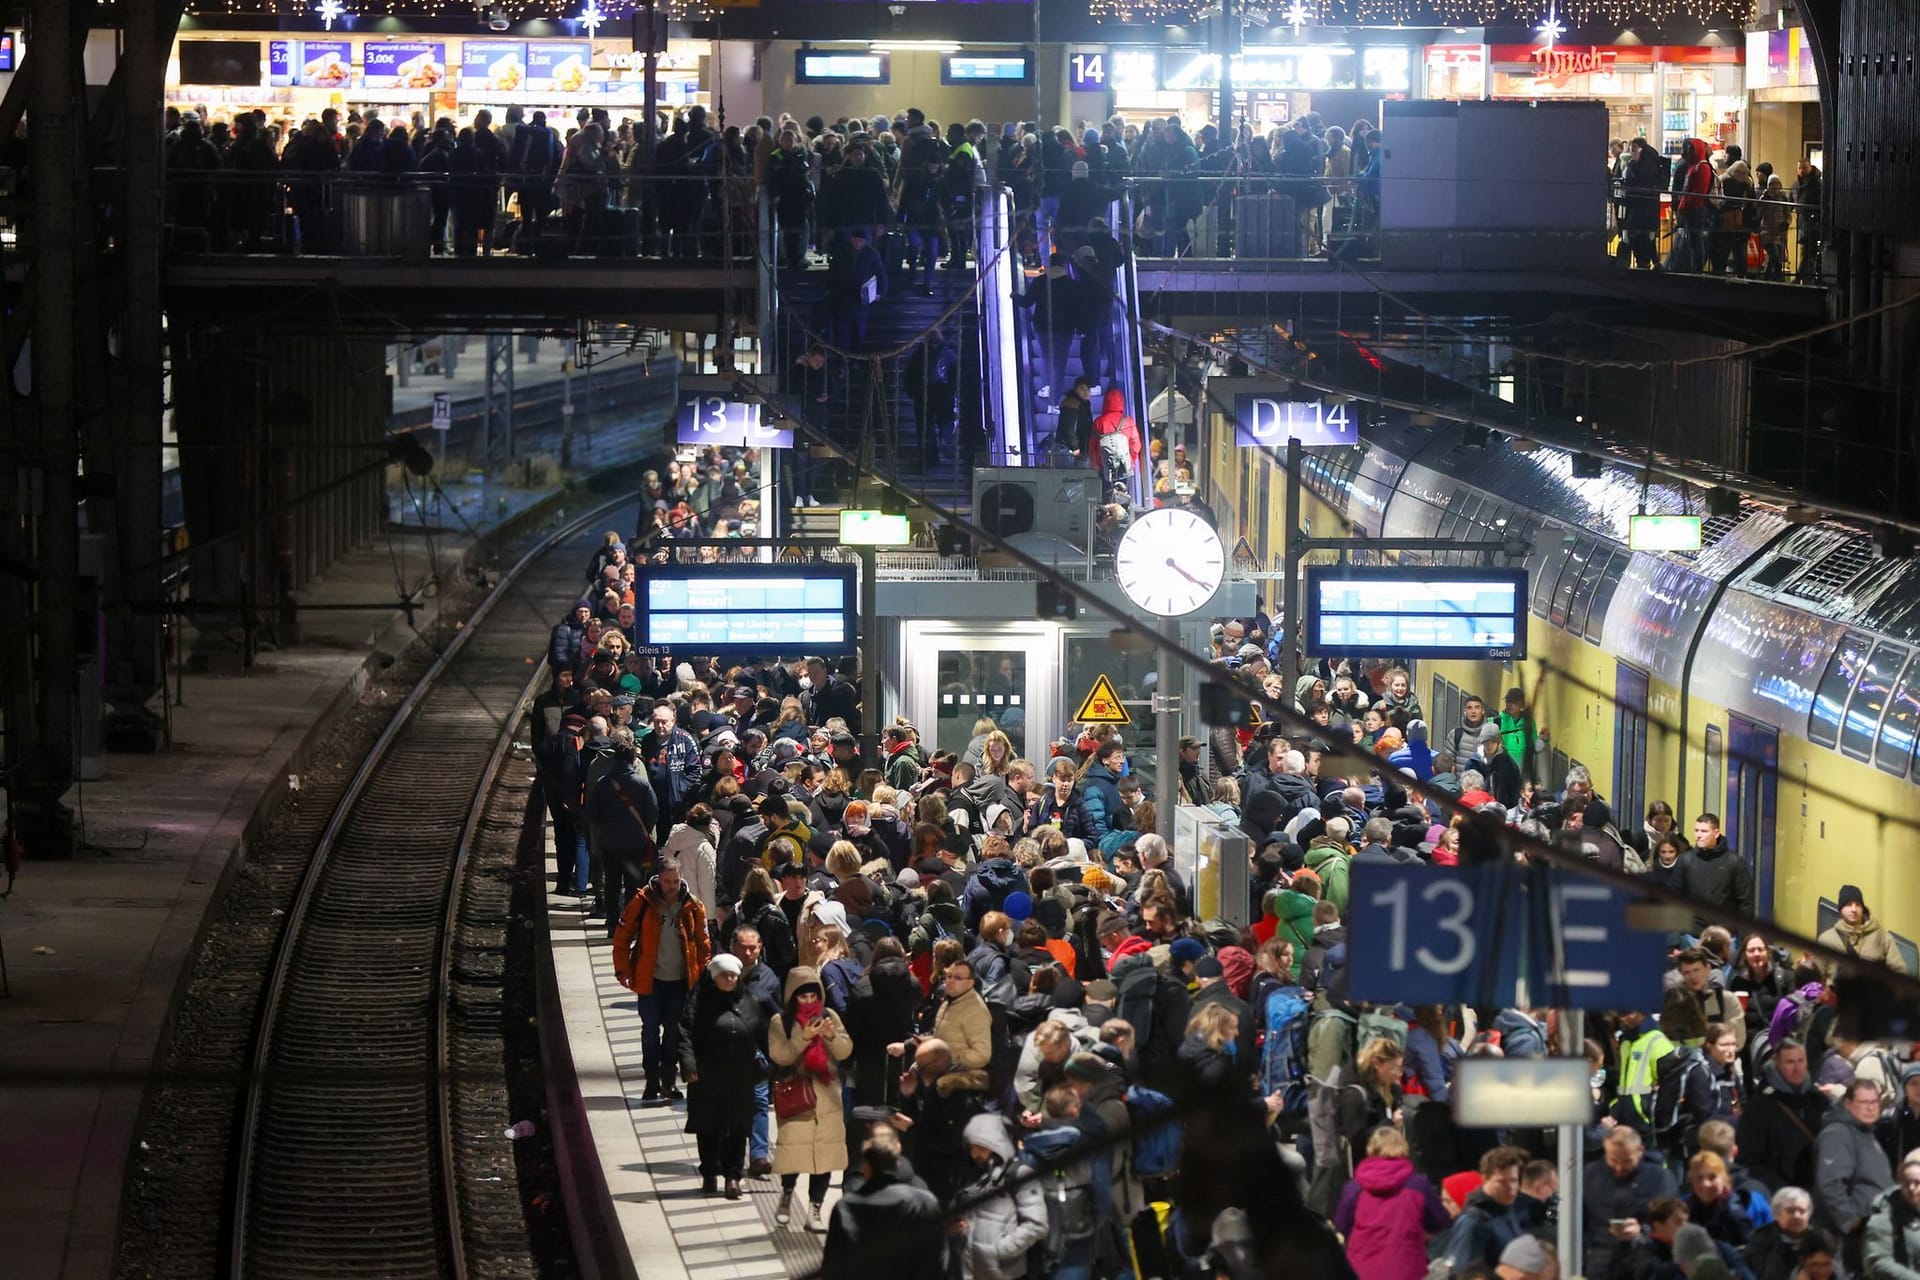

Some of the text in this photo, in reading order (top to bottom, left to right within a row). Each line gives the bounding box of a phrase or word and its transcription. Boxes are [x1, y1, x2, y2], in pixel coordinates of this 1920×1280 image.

[366, 52, 396, 64] 3,00€
[1072, 54, 1105, 84] 14
[1536, 45, 1602, 79] Ditsch
[686, 396, 728, 433] 13
[1252, 398, 1350, 437] D 14
[638, 645, 670, 655] Gleis 13
[1489, 648, 1511, 657] Gleis
[1372, 879, 1612, 987] 13 E
